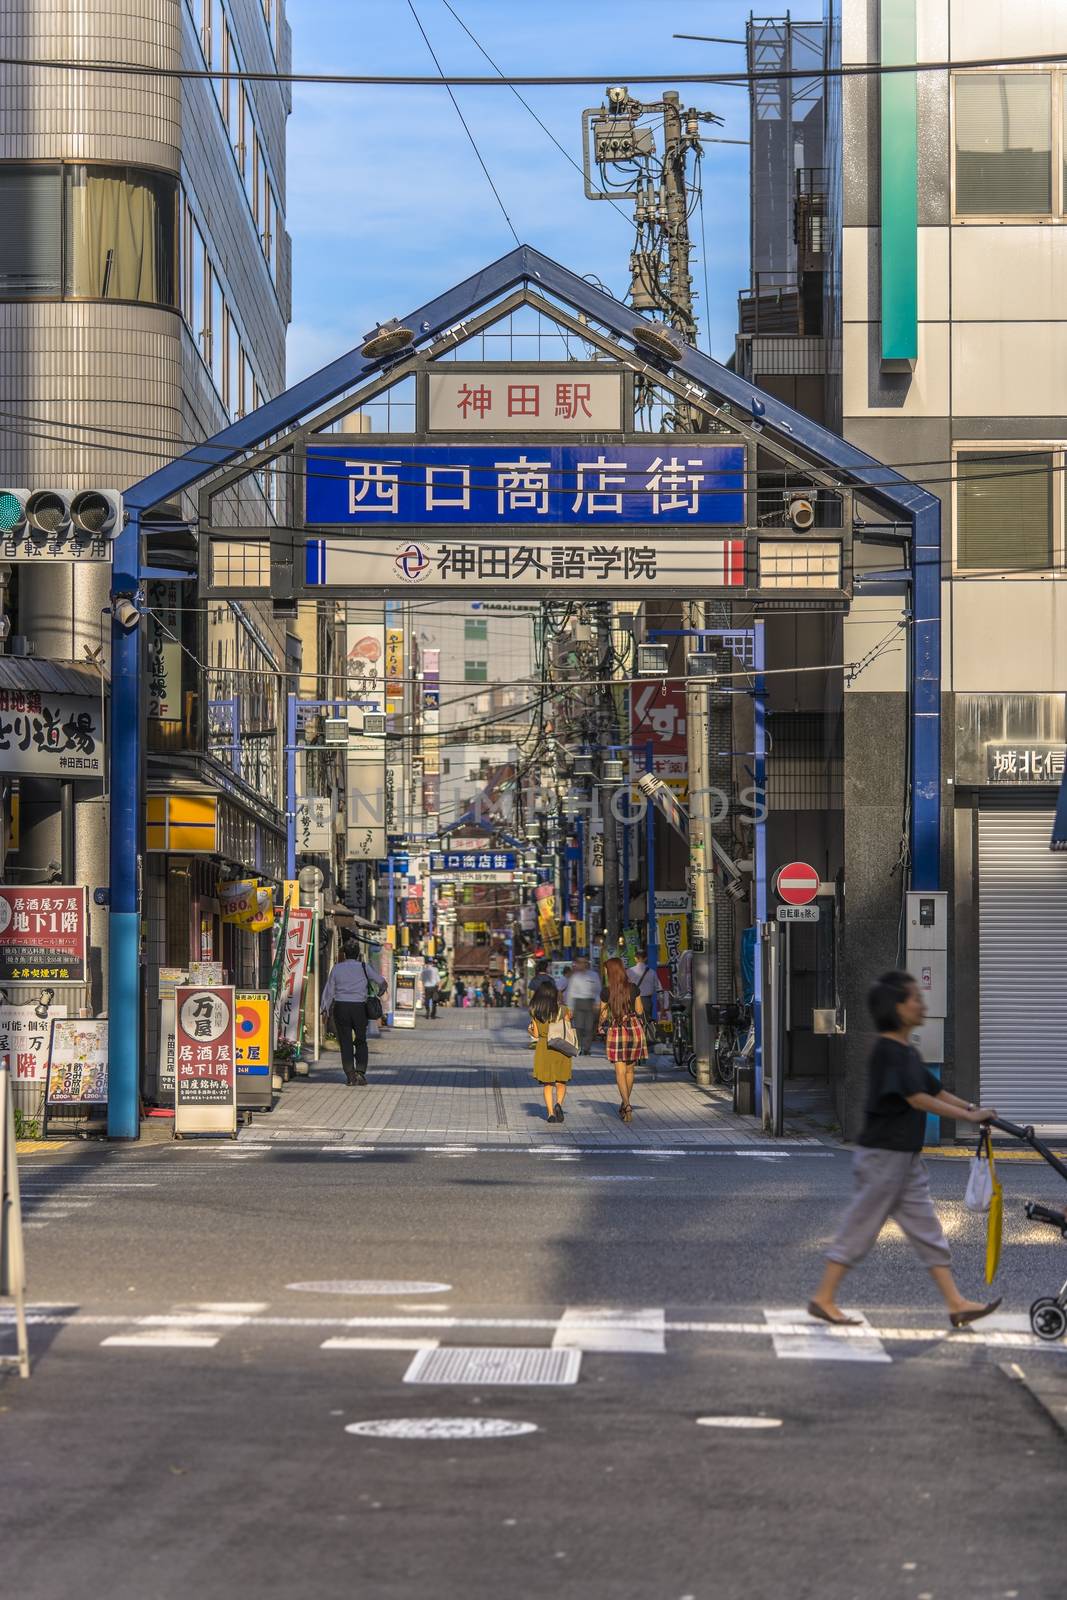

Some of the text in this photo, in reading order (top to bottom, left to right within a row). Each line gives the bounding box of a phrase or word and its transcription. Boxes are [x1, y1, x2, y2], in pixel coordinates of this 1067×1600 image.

[457, 383, 593, 420] 神田駅
[345, 455, 705, 515] 西口商店街
[5, 534, 106, 557] 自転車専用
[436, 545, 658, 580] 神田外語学院
[149, 701, 168, 716] 2F
[60, 757, 99, 769] 神田西口店
[993, 751, 1066, 773] 城北信
[13, 898, 79, 911] 居酒屋万屋
[780, 908, 816, 918] 自転車を除く
[12, 911, 79, 933] 地下1階
[11, 968, 70, 978] 全席喫煙可能
[192, 996, 214, 1037] 万屋
[179, 1045, 232, 1061] 居酒屋
[181, 1063, 229, 1076] 地下1階
